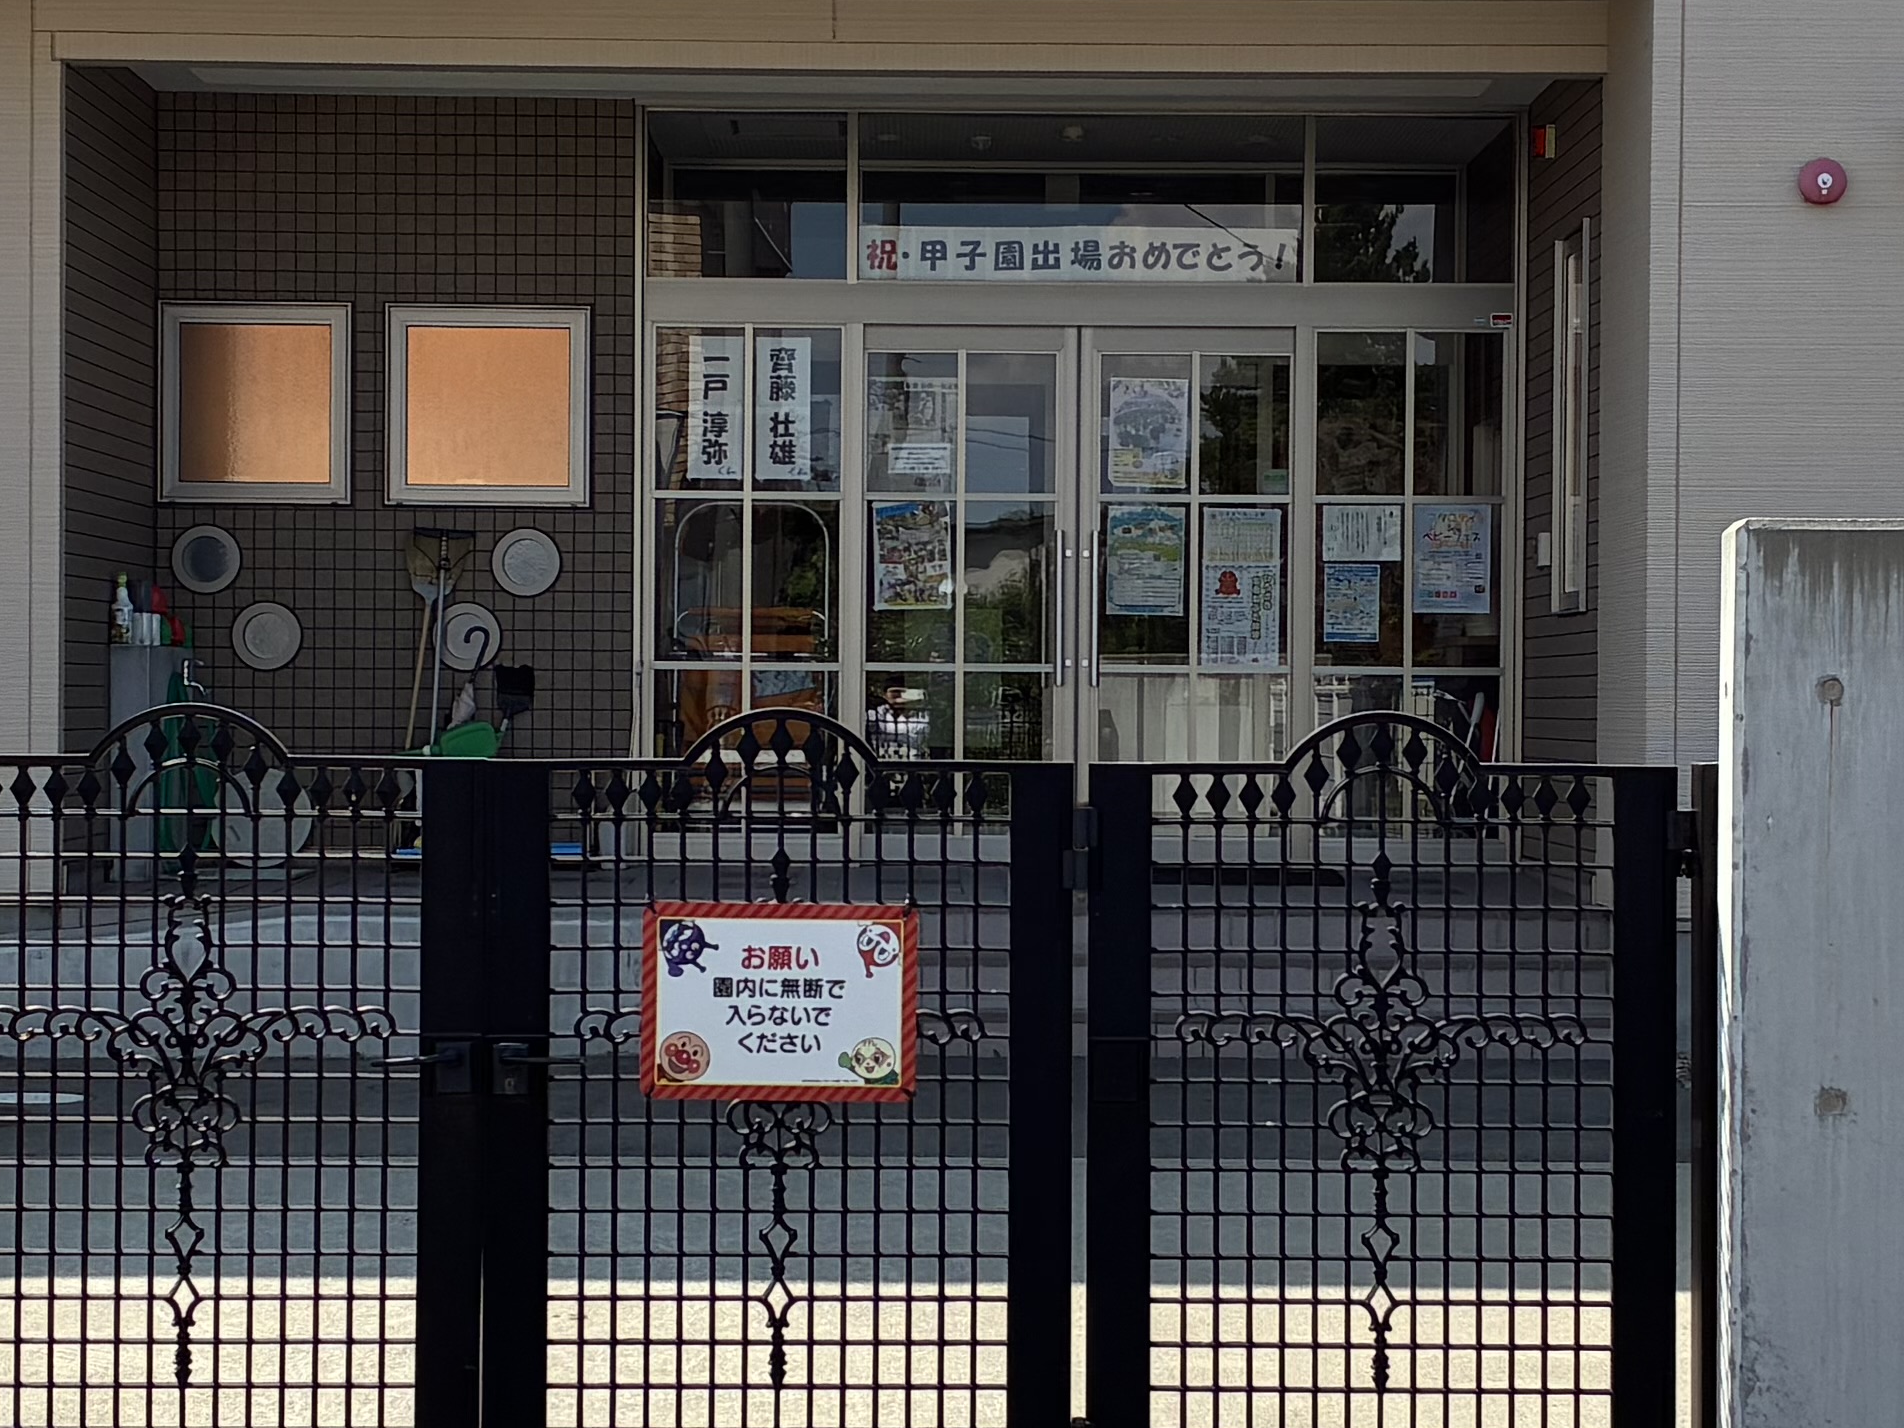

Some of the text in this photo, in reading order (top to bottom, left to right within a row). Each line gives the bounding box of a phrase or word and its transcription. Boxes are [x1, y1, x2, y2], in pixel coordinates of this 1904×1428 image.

[866, 239, 1287, 272] 祝・甲子園出場おめでとう！
[741, 945, 820, 970] お願い
[713, 977, 846, 1000] 園内に無断で
[726, 1005, 832, 1026] 入らないで
[737, 1032, 821, 1053] ください
